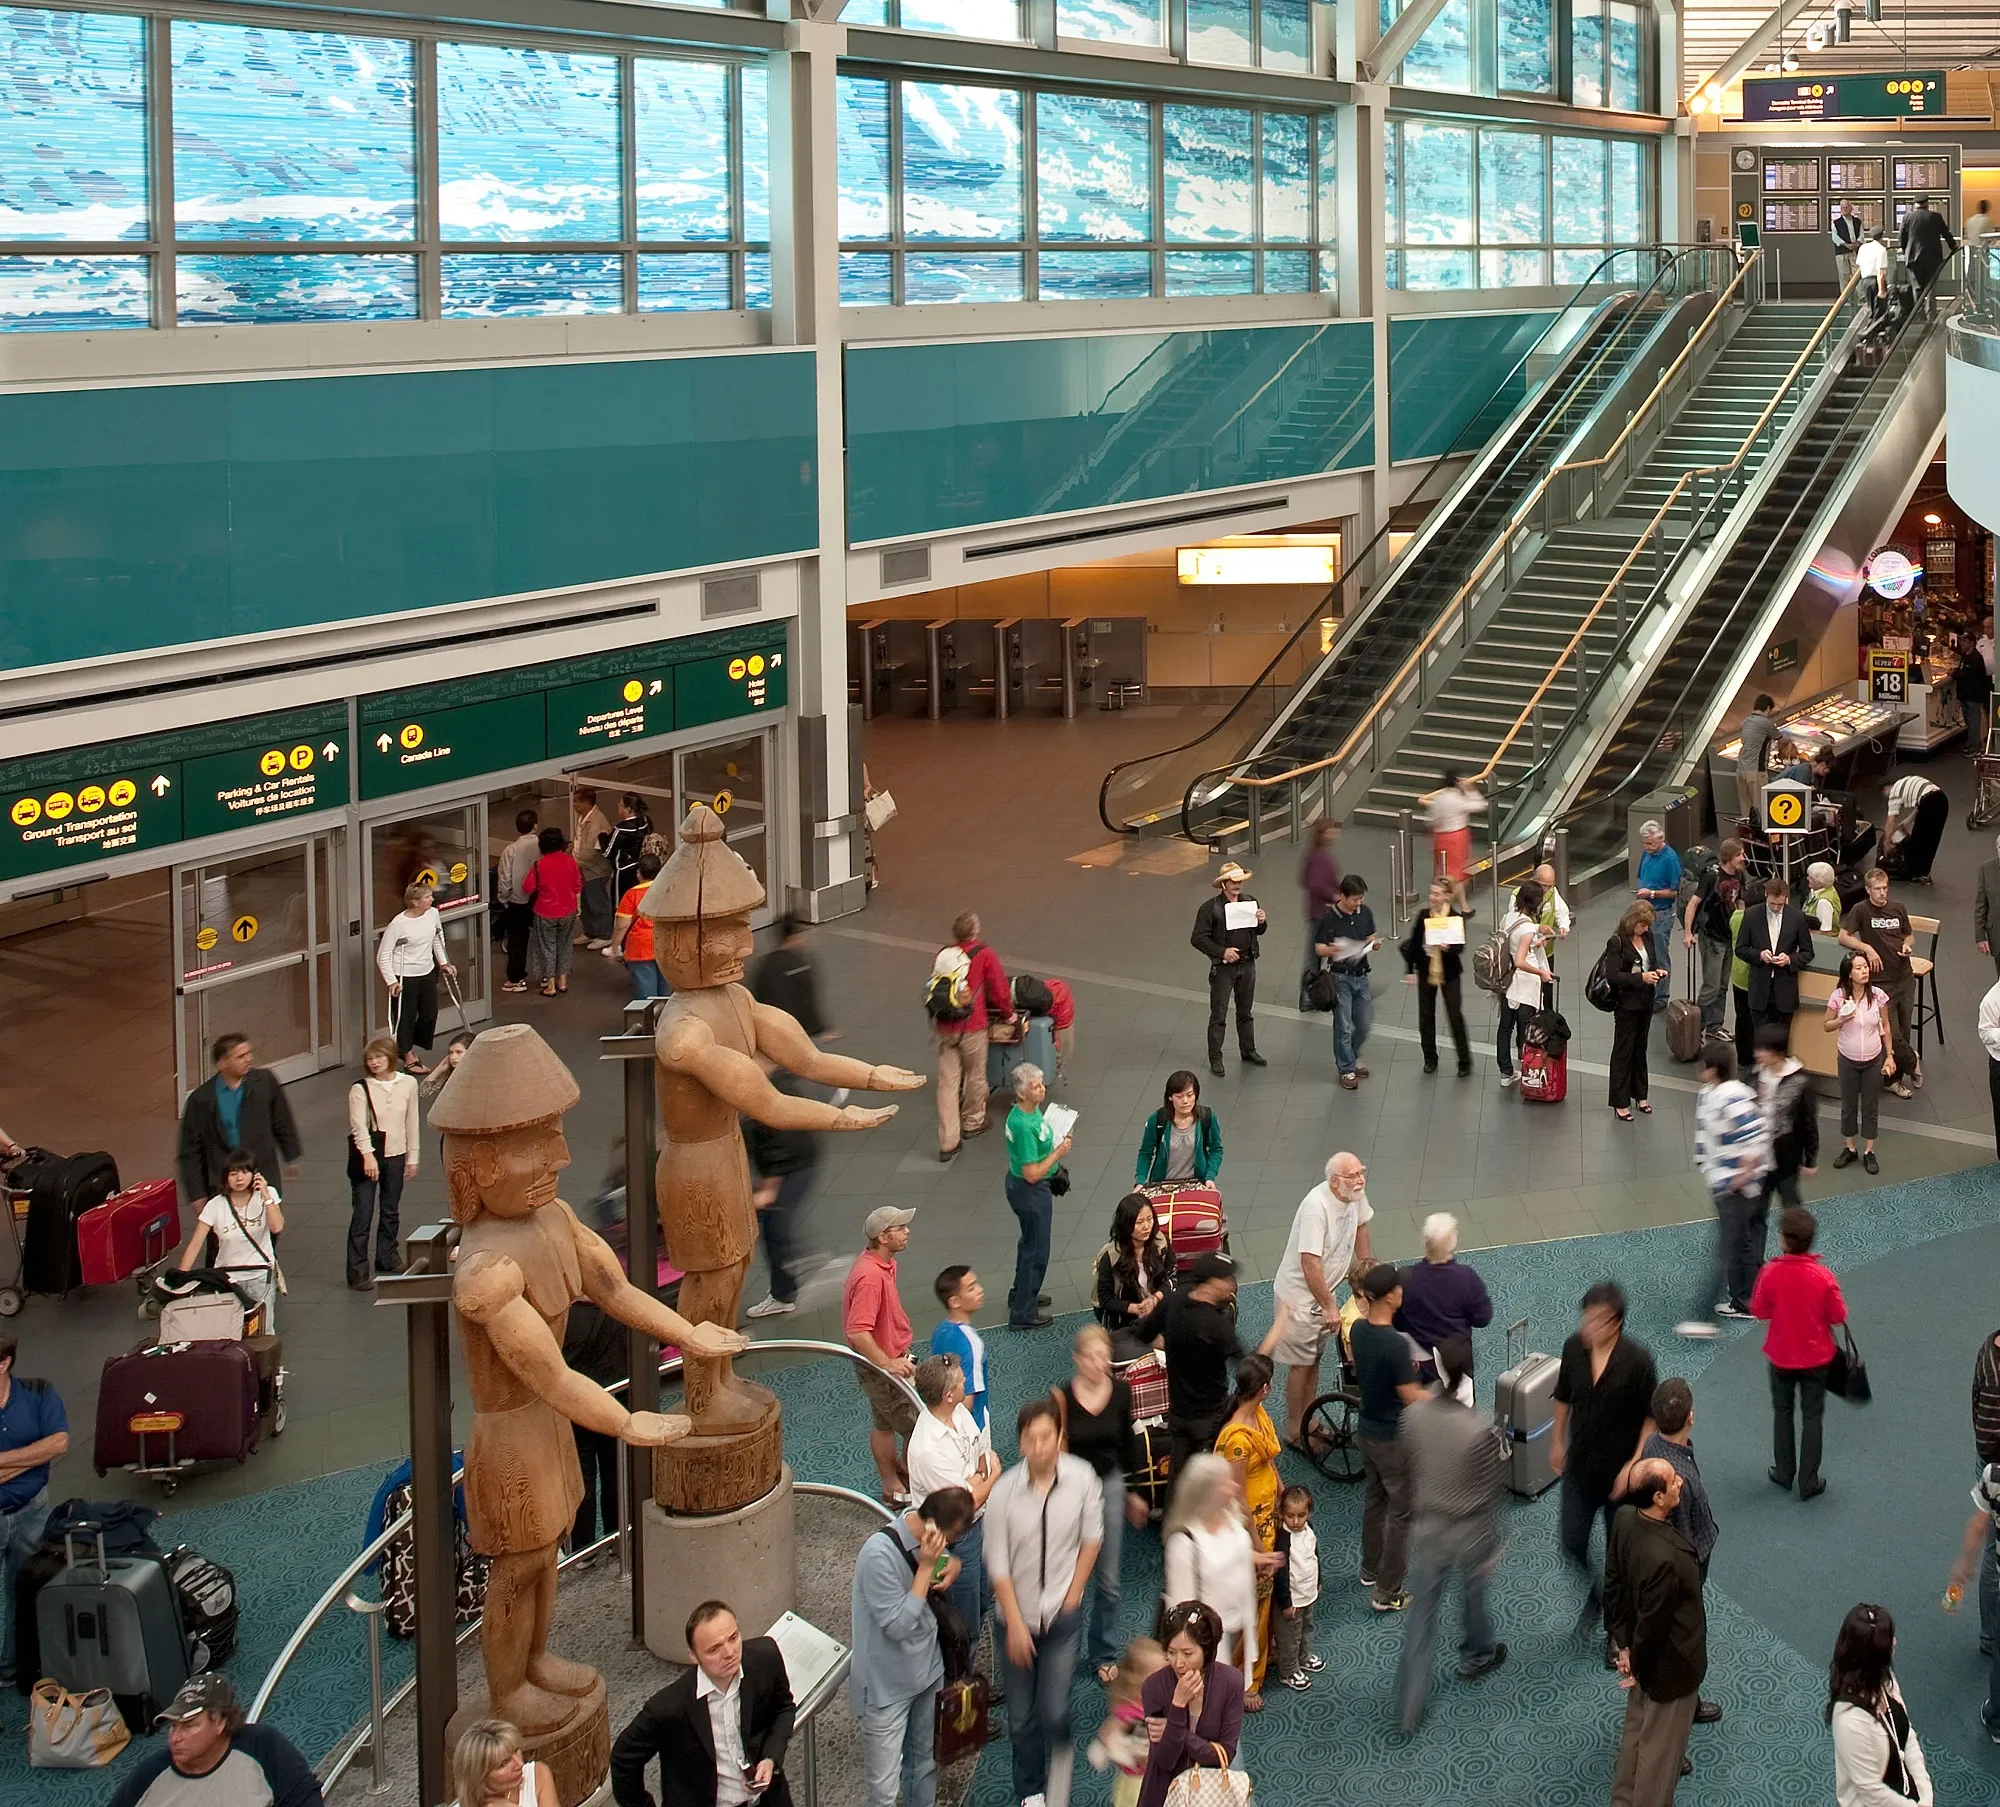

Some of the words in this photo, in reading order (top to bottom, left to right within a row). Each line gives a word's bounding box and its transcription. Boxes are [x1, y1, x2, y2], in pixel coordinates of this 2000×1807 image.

[748, 677, 765, 689] Hotel
[1875, 672, 1901, 693] $18
[587, 709, 625, 724] Departures
[624, 704, 644, 716] Level
[578, 724, 603, 736] Niveau
[603, 720, 617, 731] des
[617, 715, 644, 728] départs
[400, 750, 433, 764] Canada
[433, 747, 451, 757] Line
[217, 786, 253, 801] Parking
[253, 783, 263, 794] &
[263, 780, 281, 792] Car
[281, 773, 316, 788] Rentals
[227, 796, 265, 811] Voitures
[266, 792, 279, 803] de
[280, 784, 316, 799] location
[22, 824, 63, 842] Ground
[63, 810, 138, 833] Transportation
[55, 828, 105, 847] Transport
[106, 826, 120, 836] au
[121, 821, 137, 834] sol
